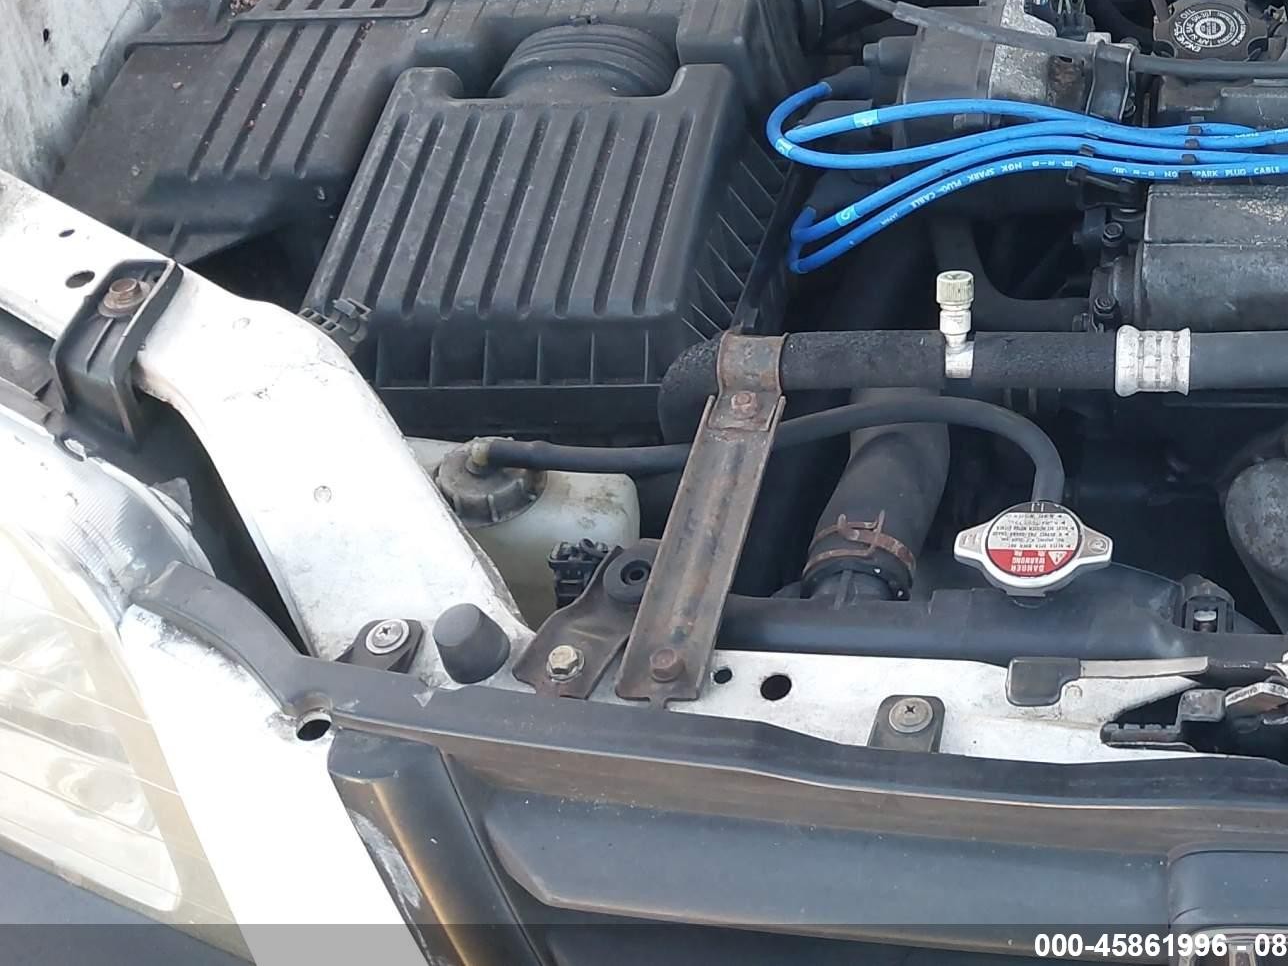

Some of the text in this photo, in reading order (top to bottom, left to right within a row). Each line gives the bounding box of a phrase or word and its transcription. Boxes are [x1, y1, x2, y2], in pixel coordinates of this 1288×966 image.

[1180, 8, 1195, 19] OIL
[967, 167, 995, 184] SPARK
[1225, 169, 1246, 177] PLUG
[1253, 165, 1280, 175] CABLE
[911, 193, 936, 209] CABLE
[1010, 564, 1045, 572] DANGER
